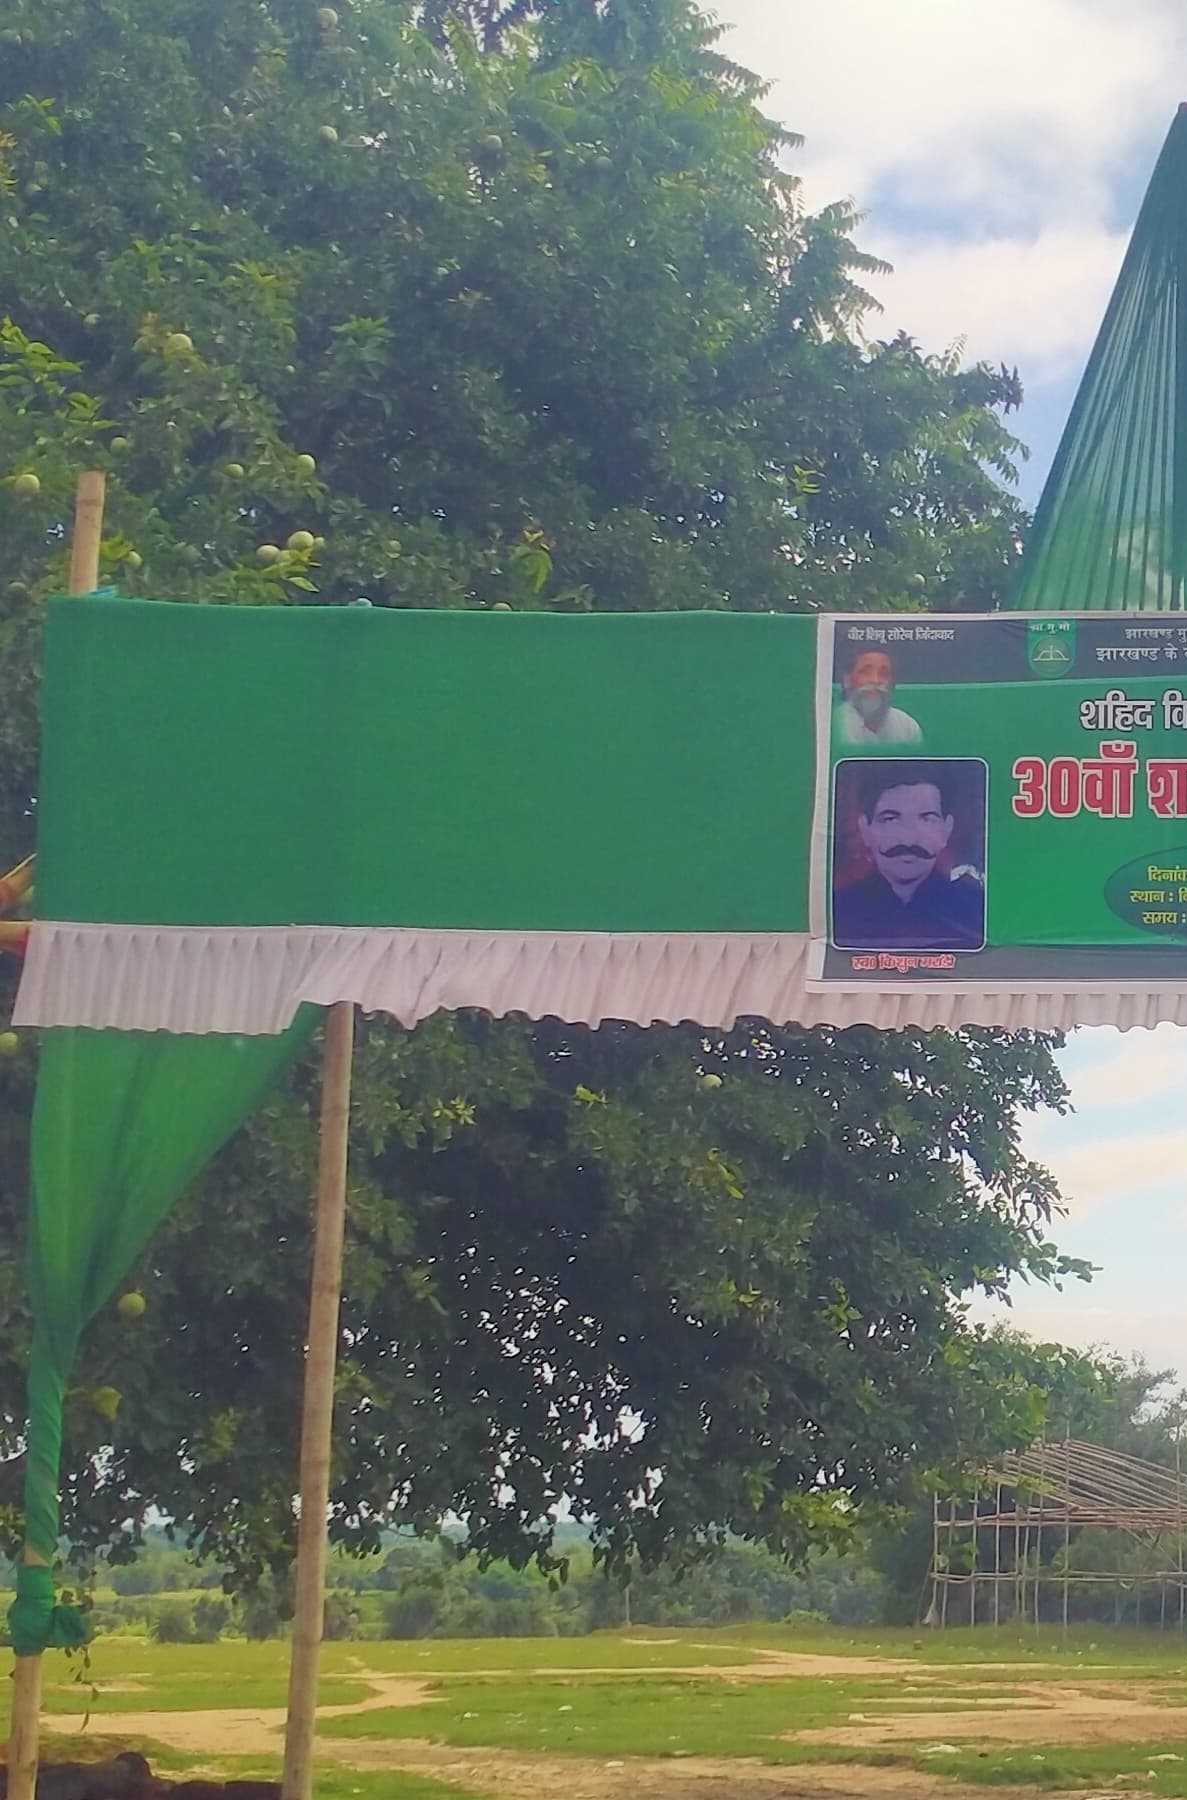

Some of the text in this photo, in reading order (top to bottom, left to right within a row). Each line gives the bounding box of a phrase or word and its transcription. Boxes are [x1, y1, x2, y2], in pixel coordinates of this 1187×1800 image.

[847, 626, 865, 641] वीर
[888, 626, 914, 641] सोरेन
[1125, 627, 1175, 640] झारखण्ड
[1095, 646, 1161, 662] झारखण्ड
[1163, 643, 1178, 661] के
[1080, 689, 1156, 731] शहिद
[1012, 740, 1139, 818] 30वाँ
[1129, 889, 1165, 903] स्थान
[1142, 911, 1178, 924] समय
